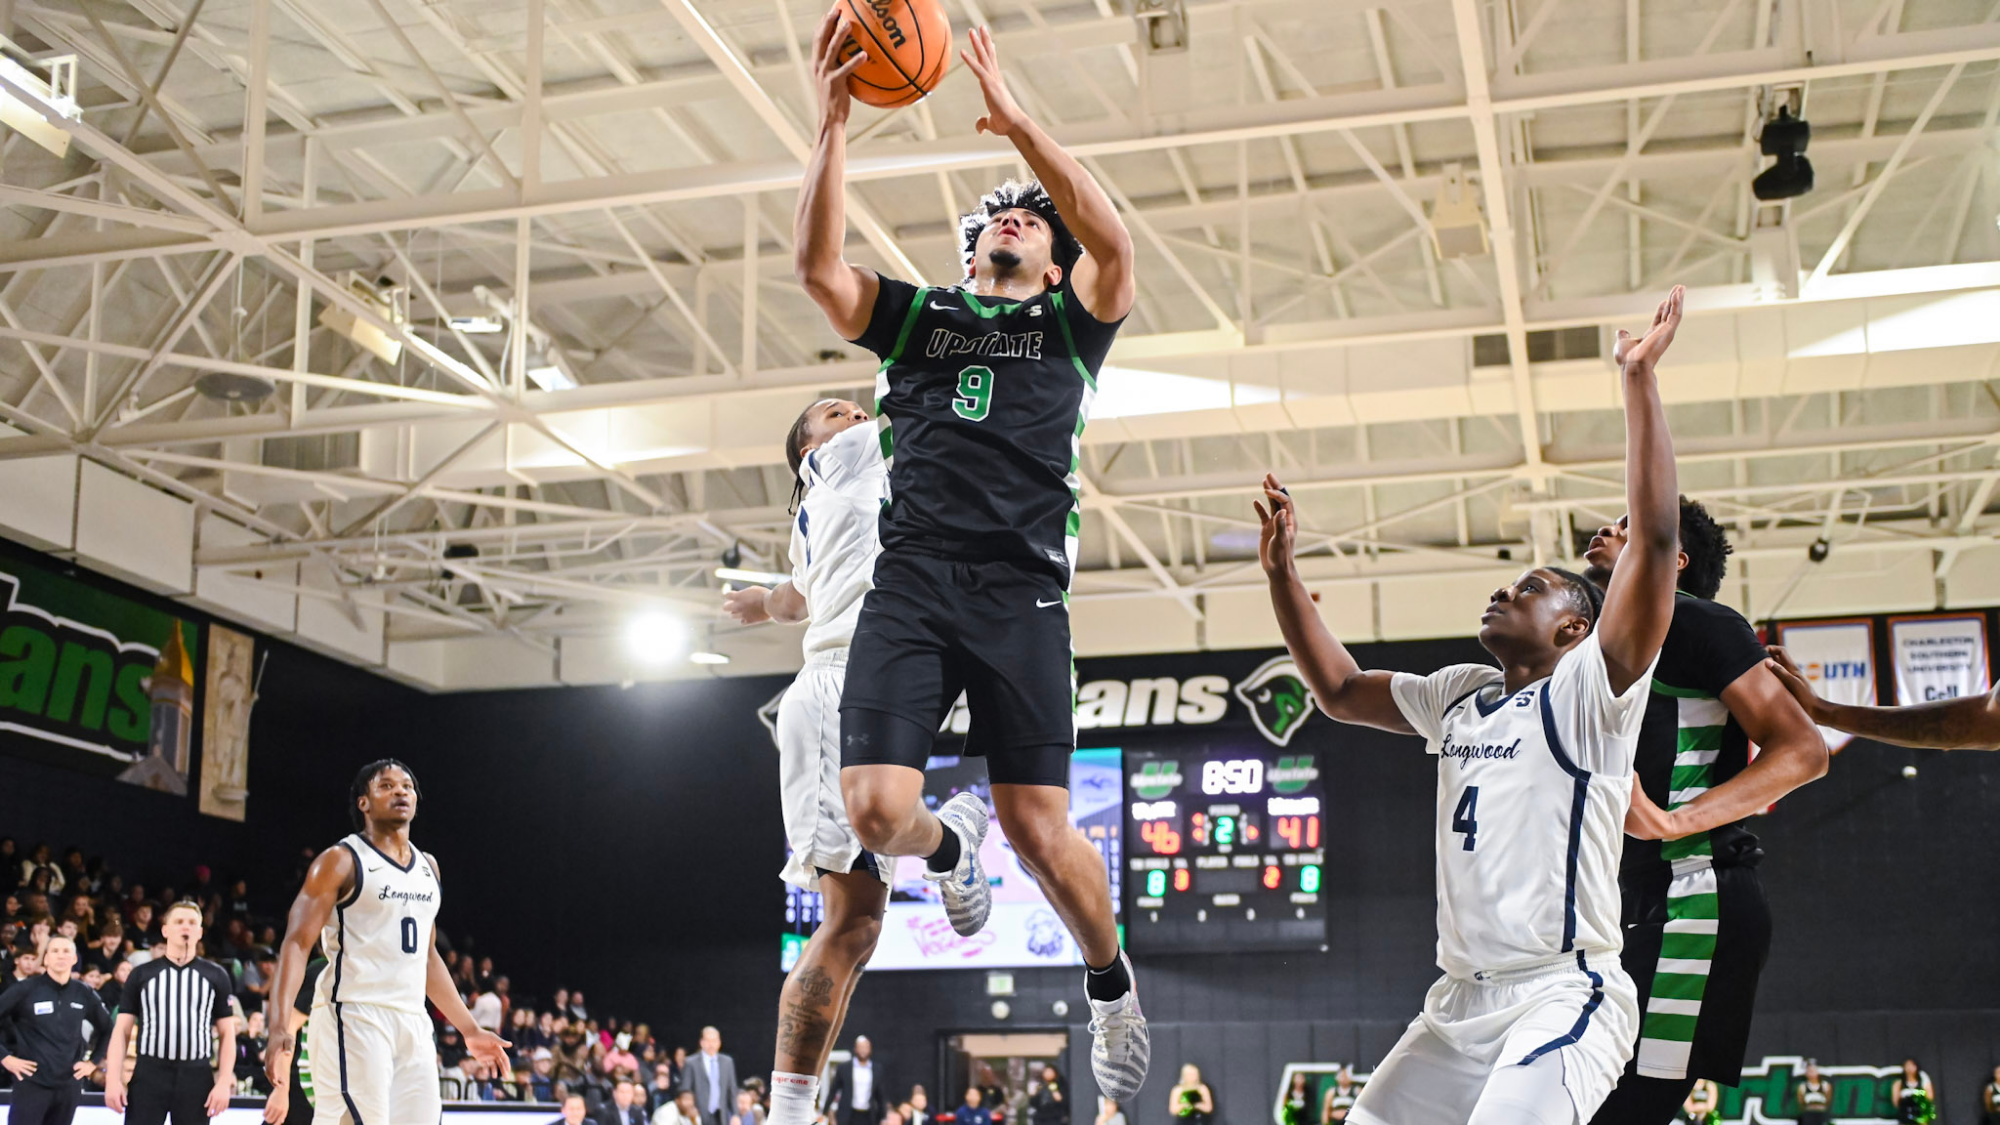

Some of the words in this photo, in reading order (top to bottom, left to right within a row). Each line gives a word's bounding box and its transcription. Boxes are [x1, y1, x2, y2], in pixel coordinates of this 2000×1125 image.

[926, 328, 1044, 360] UPSTATE
[951, 365, 995, 422] 9
[1077, 676, 1230, 730] ans
[1440, 733, 1522, 770] Longwood
[1214, 816, 1235, 844] 2
[1277, 816, 1320, 848] 41
[1452, 785, 1479, 852] 4
[1141, 821, 1181, 855] 46
[1147, 869, 1166, 897] 8
[1300, 864, 1320, 893] 8
[378, 885, 433, 906] Longwood
[401, 916, 418, 955] 0
